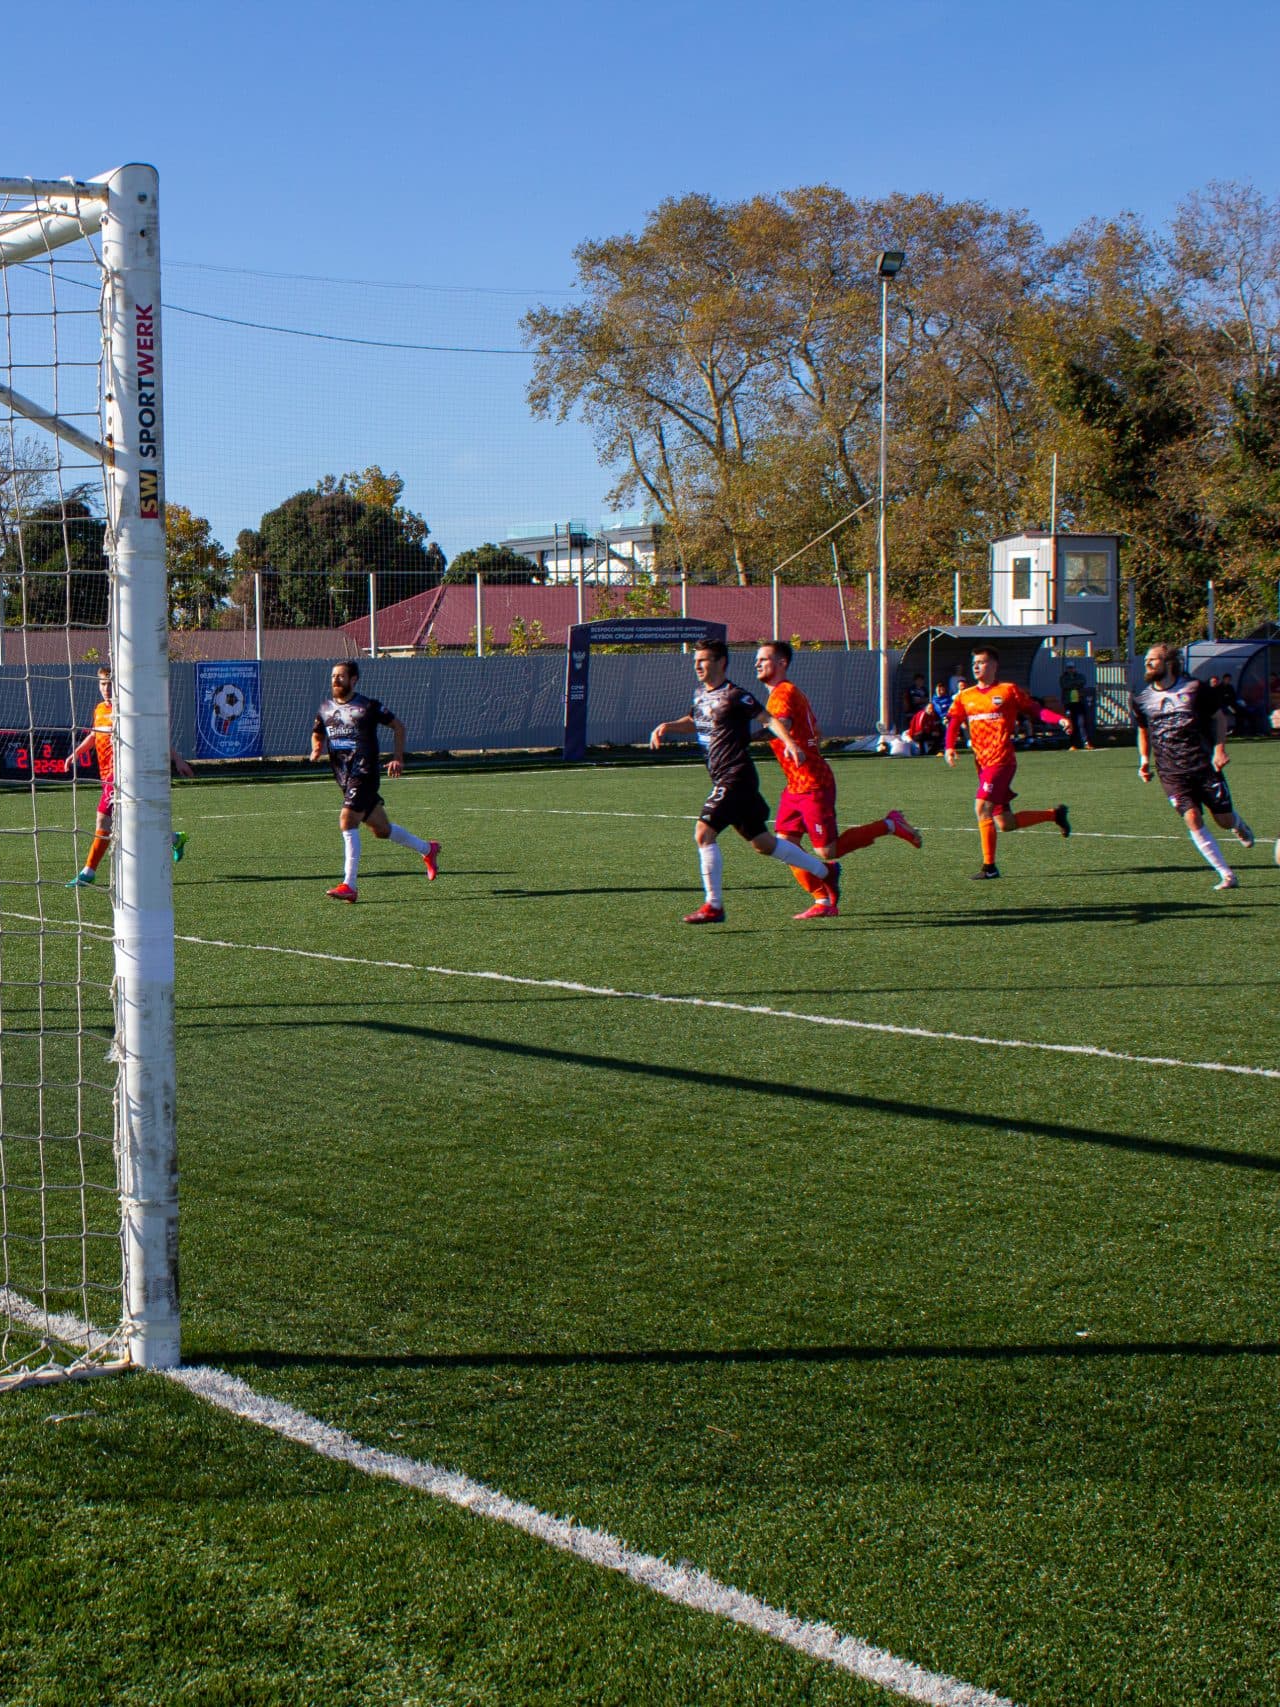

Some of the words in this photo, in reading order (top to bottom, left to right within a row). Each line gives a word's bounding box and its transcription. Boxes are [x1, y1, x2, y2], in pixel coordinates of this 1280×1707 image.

[135, 303, 157, 458] SPORTWERK
[139, 471, 159, 515] SW
[16, 749, 28, 769] 2
[348, 787, 357, 799] 5
